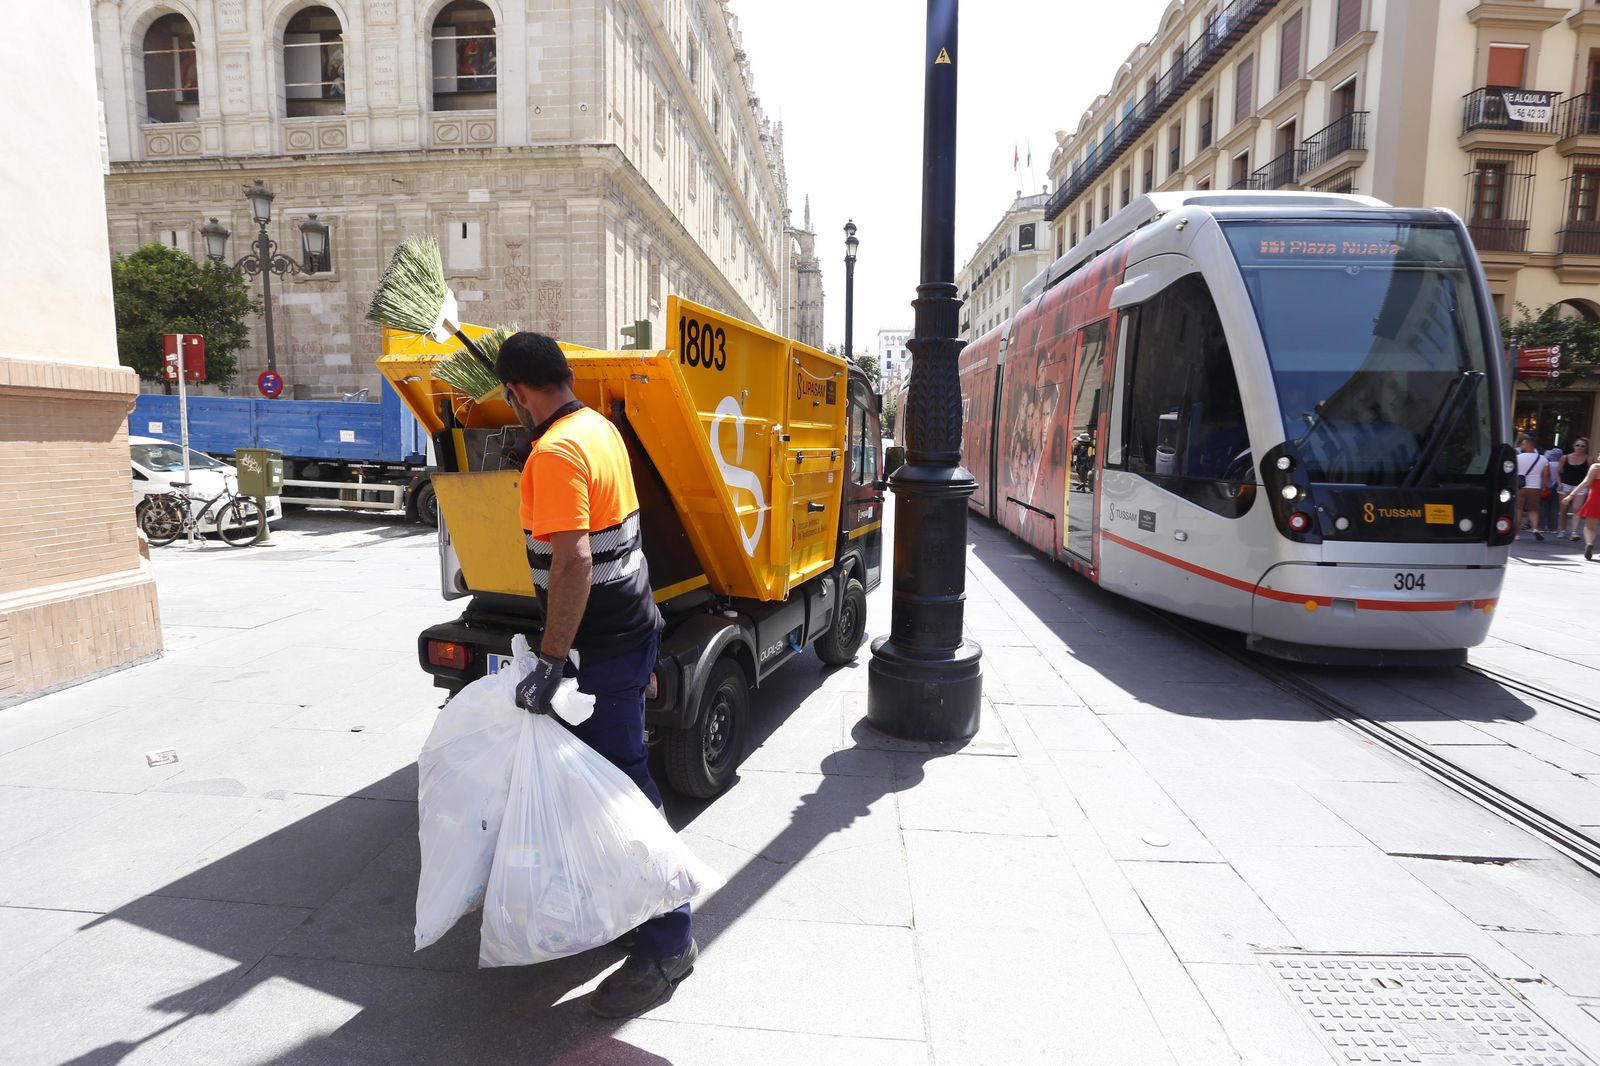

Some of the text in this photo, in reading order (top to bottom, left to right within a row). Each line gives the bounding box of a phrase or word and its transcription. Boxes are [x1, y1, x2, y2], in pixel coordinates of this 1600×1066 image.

[1515, 93, 1547, 104] ALQUILA
[1290, 240, 1337, 255] Plaza
[1341, 240, 1401, 255] Nueva
[679, 315, 727, 372] 1803
[802, 380, 826, 398] LIPASAM
[1116, 508, 1137, 522] TUSSAM
[1377, 508, 1422, 518] TUSSAM
[1393, 572, 1426, 591] 304
